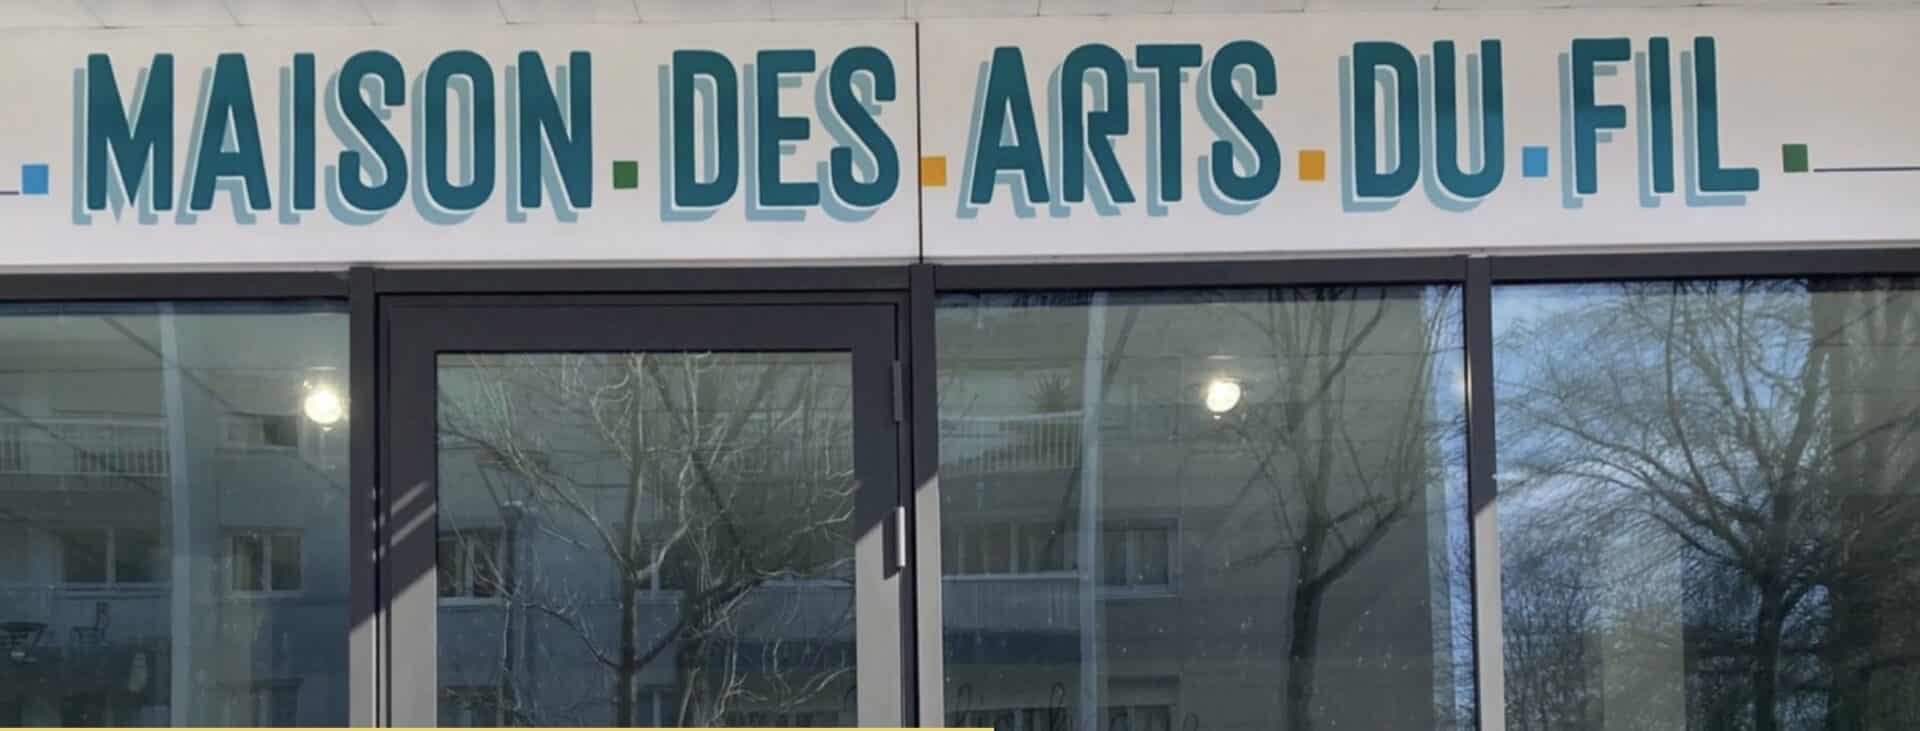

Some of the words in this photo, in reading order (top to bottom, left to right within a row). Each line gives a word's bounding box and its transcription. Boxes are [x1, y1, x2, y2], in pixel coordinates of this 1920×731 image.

[75, 50, 594, 224] MAISON
[661, 47, 900, 223] DES
[958, 41, 1281, 219] ARTS
[1341, 40, 1505, 213] DU
[1559, 37, 1760, 208] FIL
